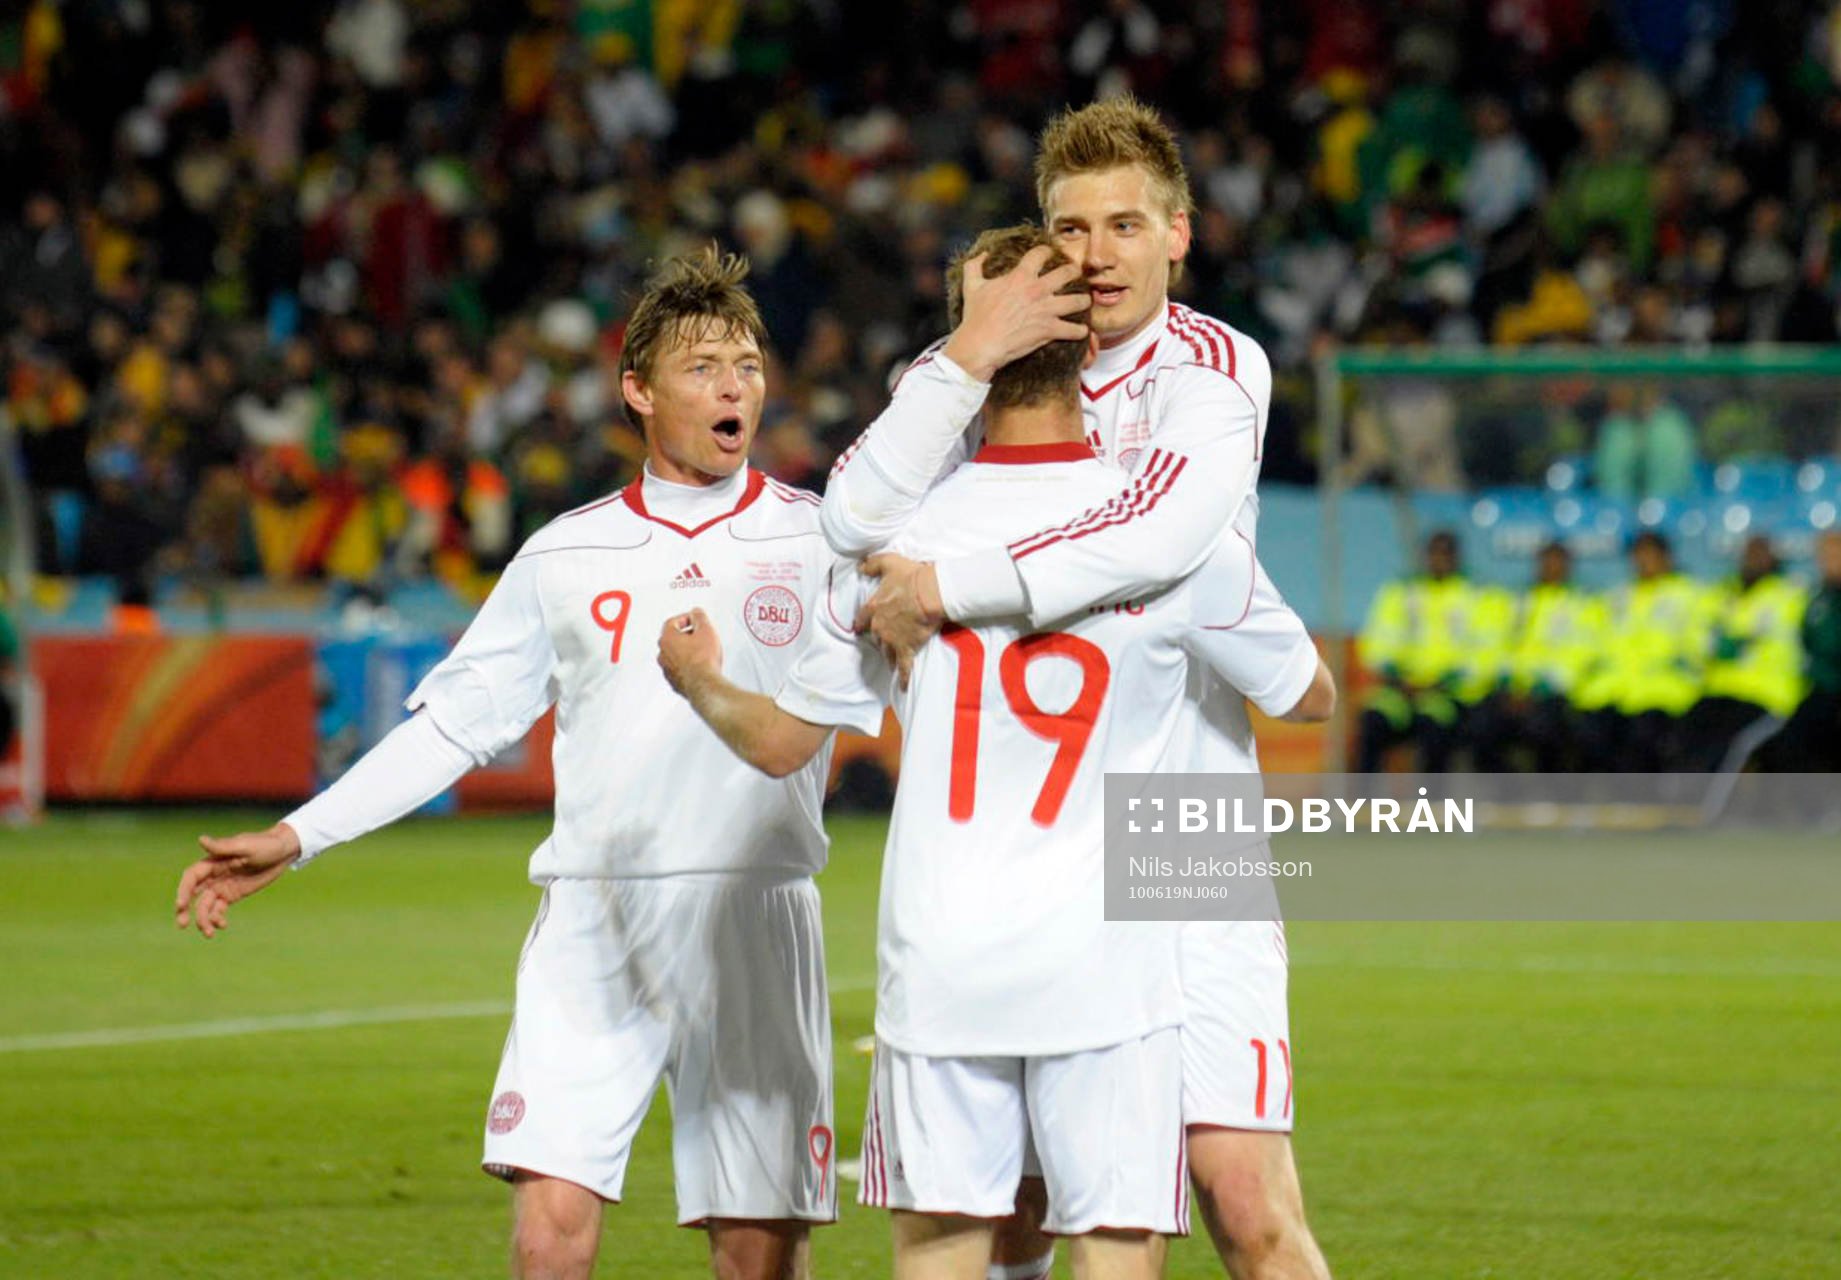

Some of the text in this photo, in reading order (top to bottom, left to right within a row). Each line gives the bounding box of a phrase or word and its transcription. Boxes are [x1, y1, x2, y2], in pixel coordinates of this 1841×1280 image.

[669, 578, 711, 589] adidas
[758, 605, 789, 623] DBU
[590, 590, 631, 663] 9
[940, 621, 1111, 829] 19
[1250, 1038, 1292, 1119] 11
[808, 1124, 832, 1202] 9
